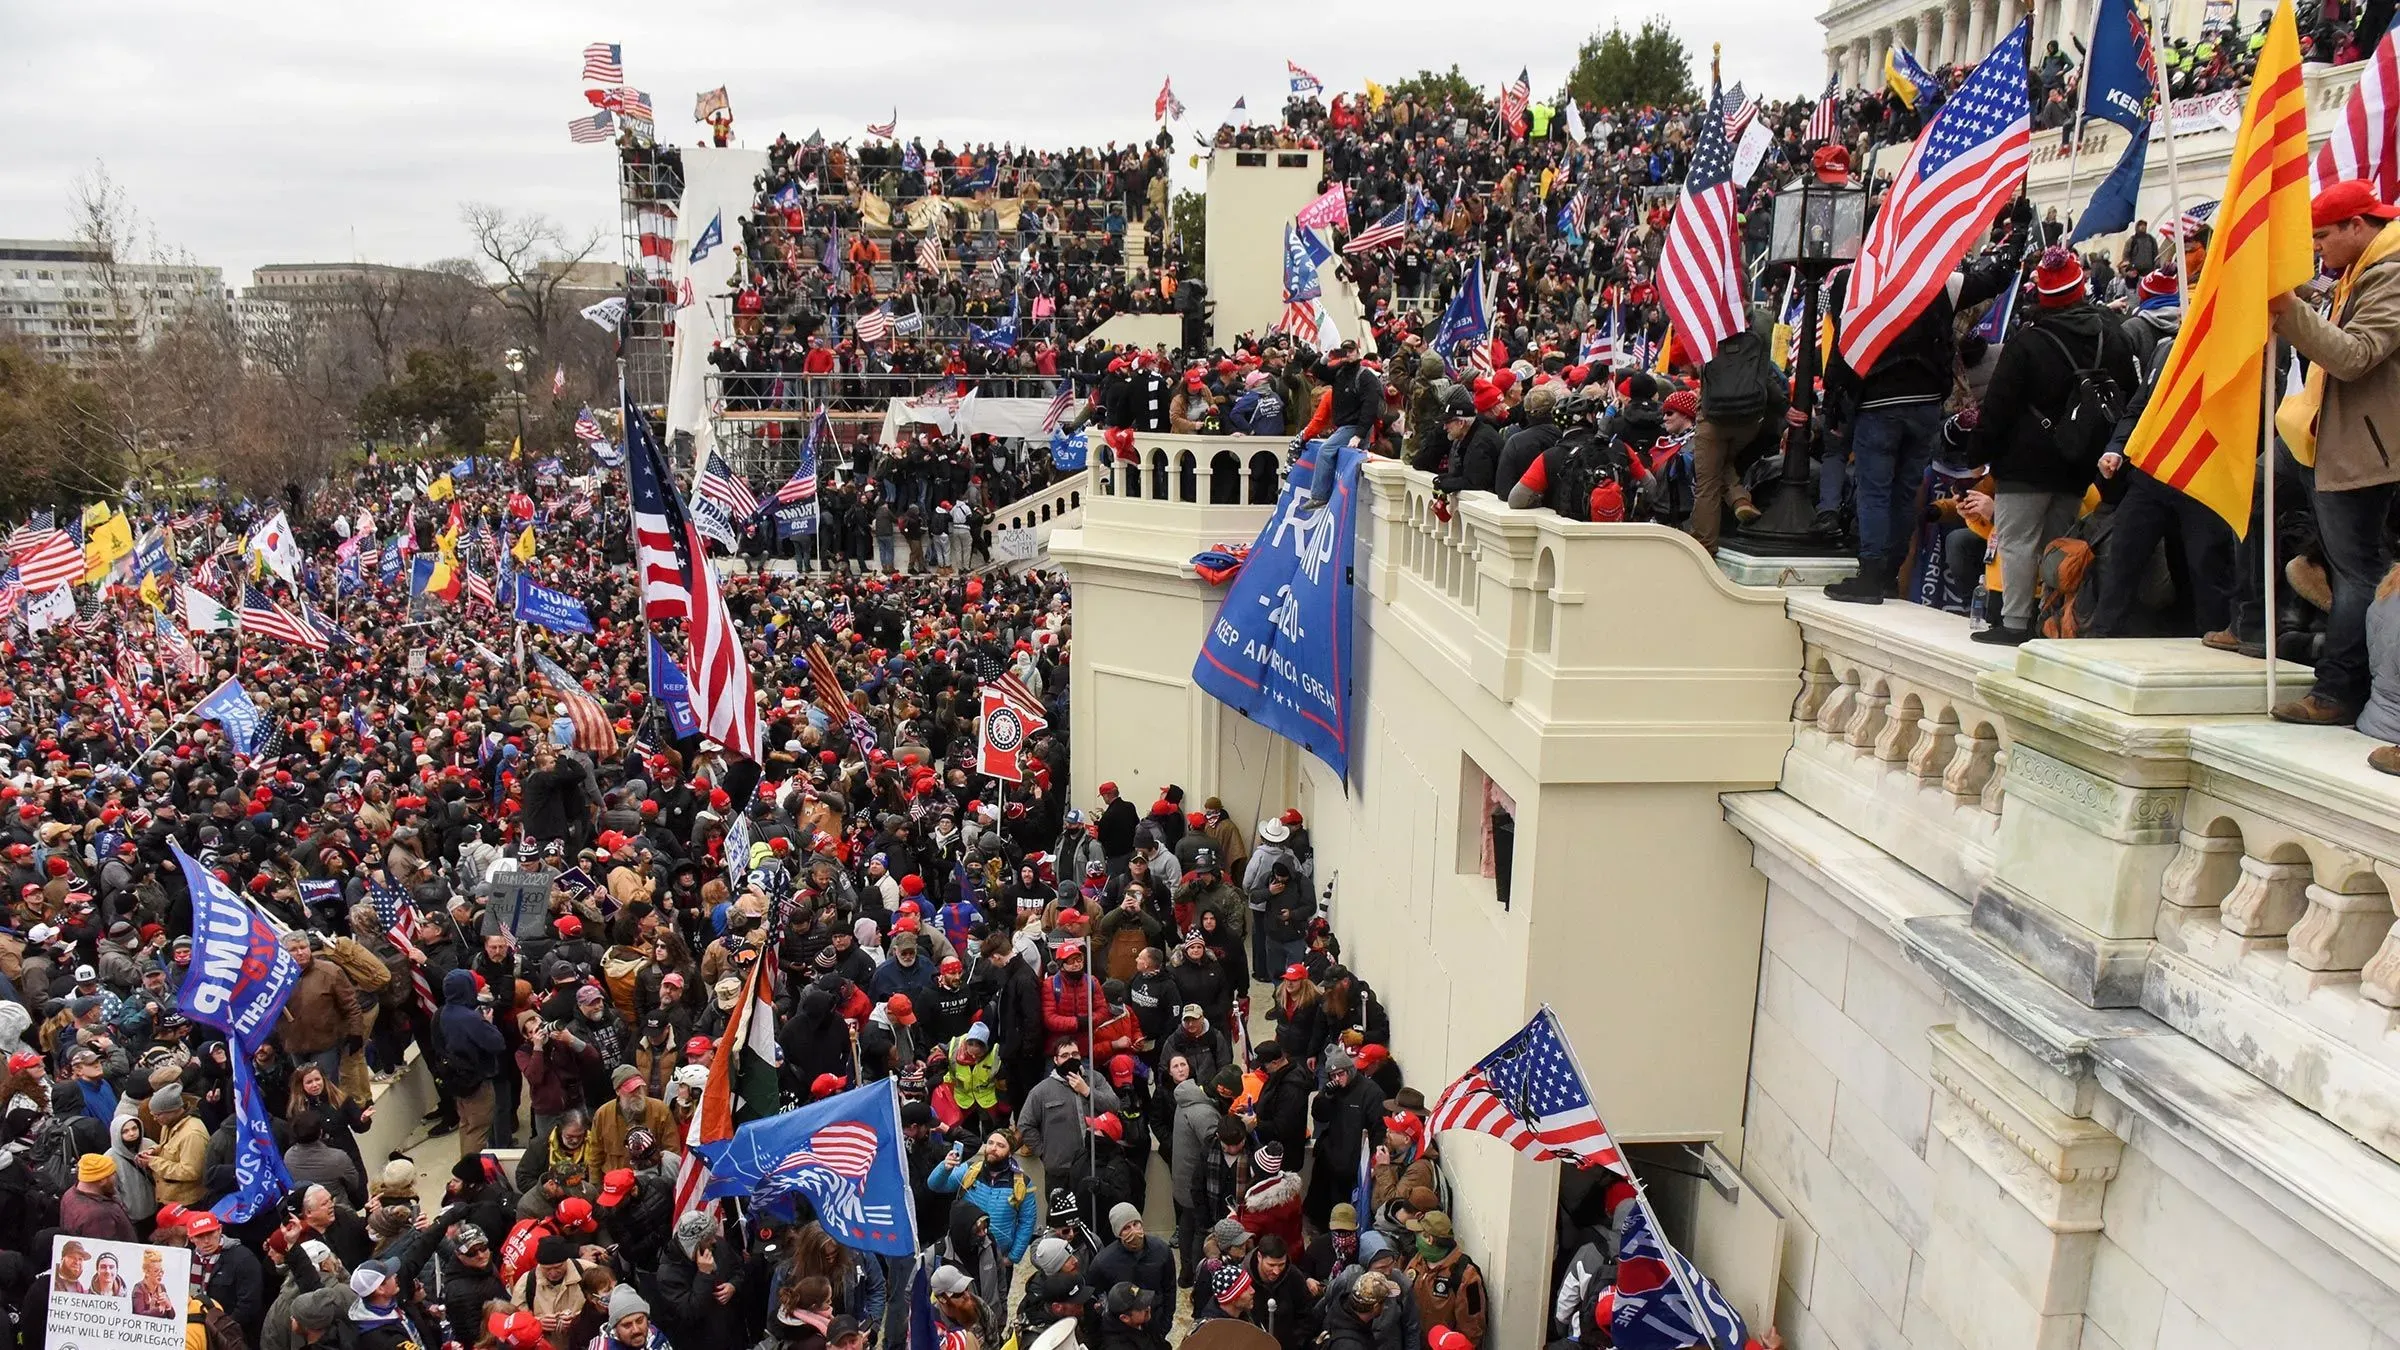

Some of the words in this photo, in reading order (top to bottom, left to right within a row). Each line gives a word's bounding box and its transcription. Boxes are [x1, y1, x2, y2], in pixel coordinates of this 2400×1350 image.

[529, 584, 584, 609] TRUMP
[1214, 616, 1239, 647] KEEP
[1302, 673, 1337, 716] GREAT
[523, 873, 550, 886] 2020
[1016, 897, 1044, 908] BIDEN
[192, 1217, 211, 1229] USA
[51, 1295, 69, 1307] HEY
[70, 1297, 121, 1312] SENATORS,
[48, 1309, 71, 1320] THEY
[73, 1312, 106, 1324] STOOD
[107, 1317, 121, 1327] UP
[122, 1318, 142, 1329] FOR
[145, 1321, 178, 1334] TRUTH.
[48, 1324, 76, 1335] WHAT
[78, 1328, 100, 1338] WILL
[103, 1330, 115, 1339] BE
[118, 1331, 145, 1343] YOUR
[144, 1334, 185, 1347] LEGACY?
